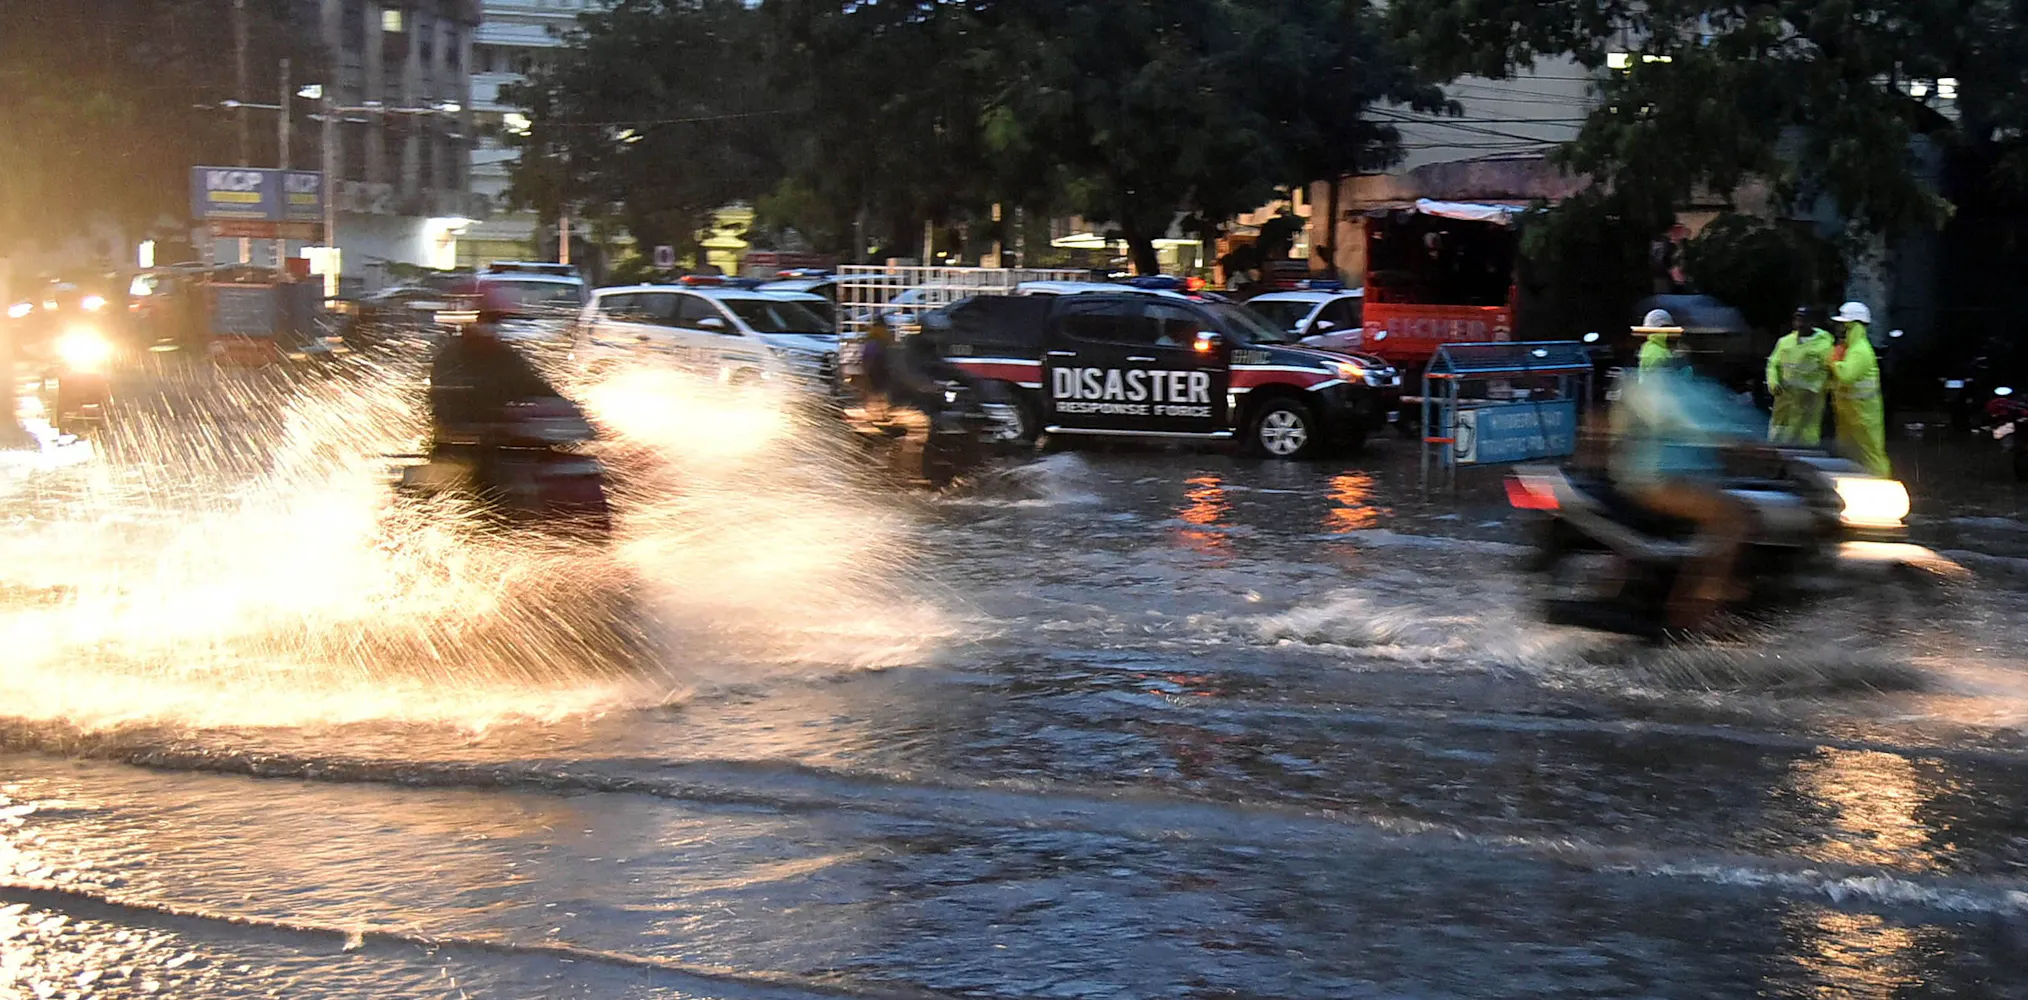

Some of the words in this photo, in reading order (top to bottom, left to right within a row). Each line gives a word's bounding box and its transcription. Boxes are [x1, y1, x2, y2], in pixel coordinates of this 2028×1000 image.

[206, 170, 263, 191] KCP
[1052, 367, 1212, 403] DISASTER
[1056, 401, 1150, 416] RESPONSE
[1154, 405, 1212, 418] FORCE
